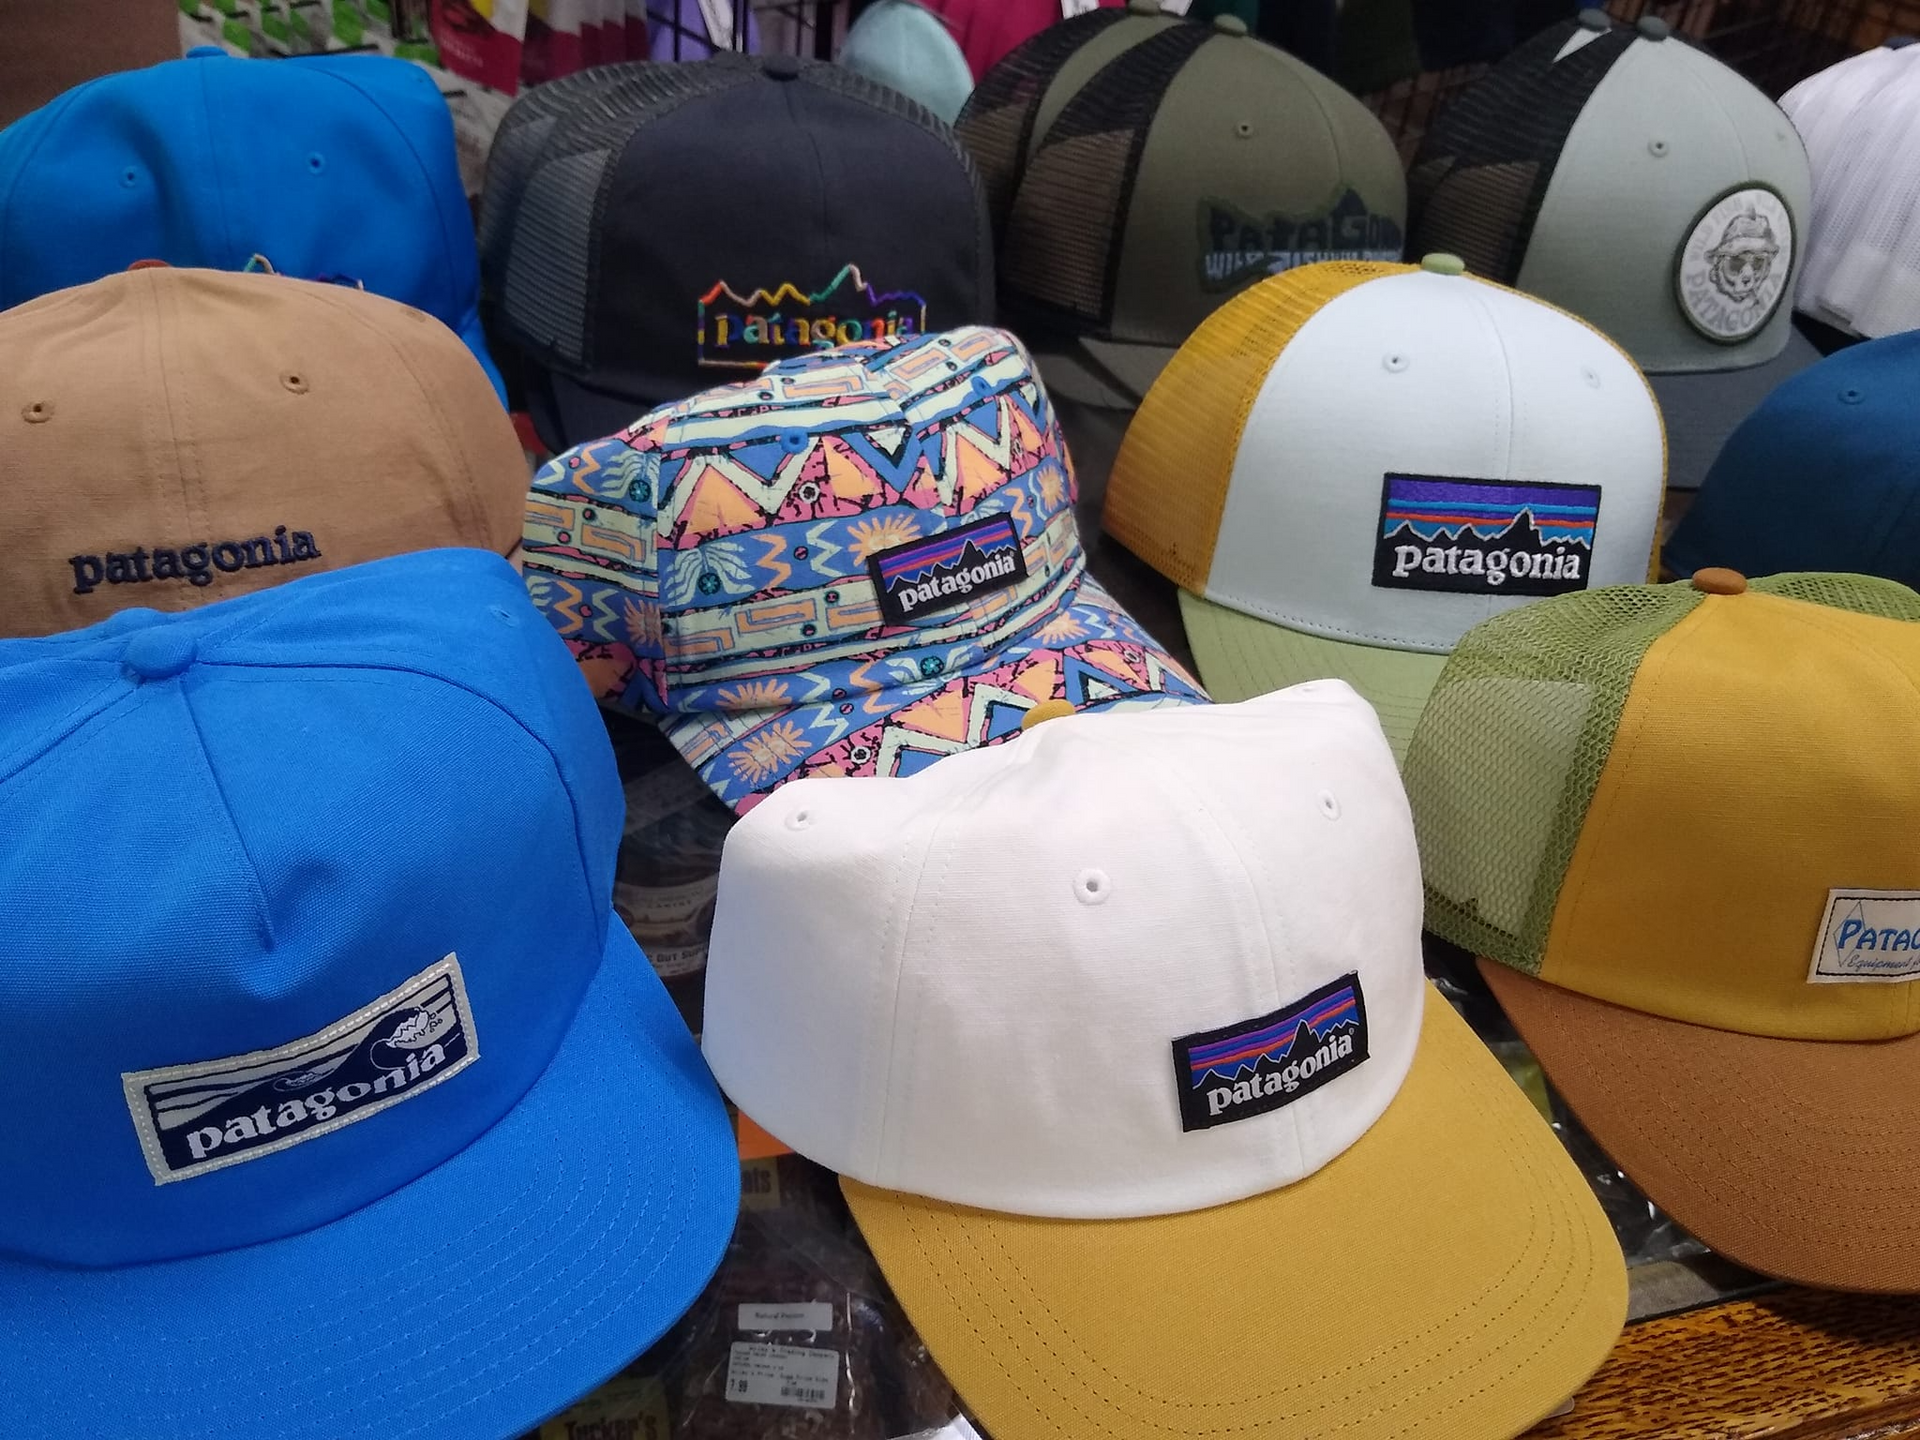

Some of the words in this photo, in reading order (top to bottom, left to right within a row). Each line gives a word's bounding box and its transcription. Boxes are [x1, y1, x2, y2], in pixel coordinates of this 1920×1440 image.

[714, 309, 914, 351] patagonia
[69, 525, 321, 594] patagonia
[898, 553, 1016, 612] patagonia
[1392, 545, 1580, 585] patagonia
[1847, 954, 1912, 972] Equipment
[186, 1043, 446, 1159] patagonia
[1206, 1034, 1353, 1116] patagonia
